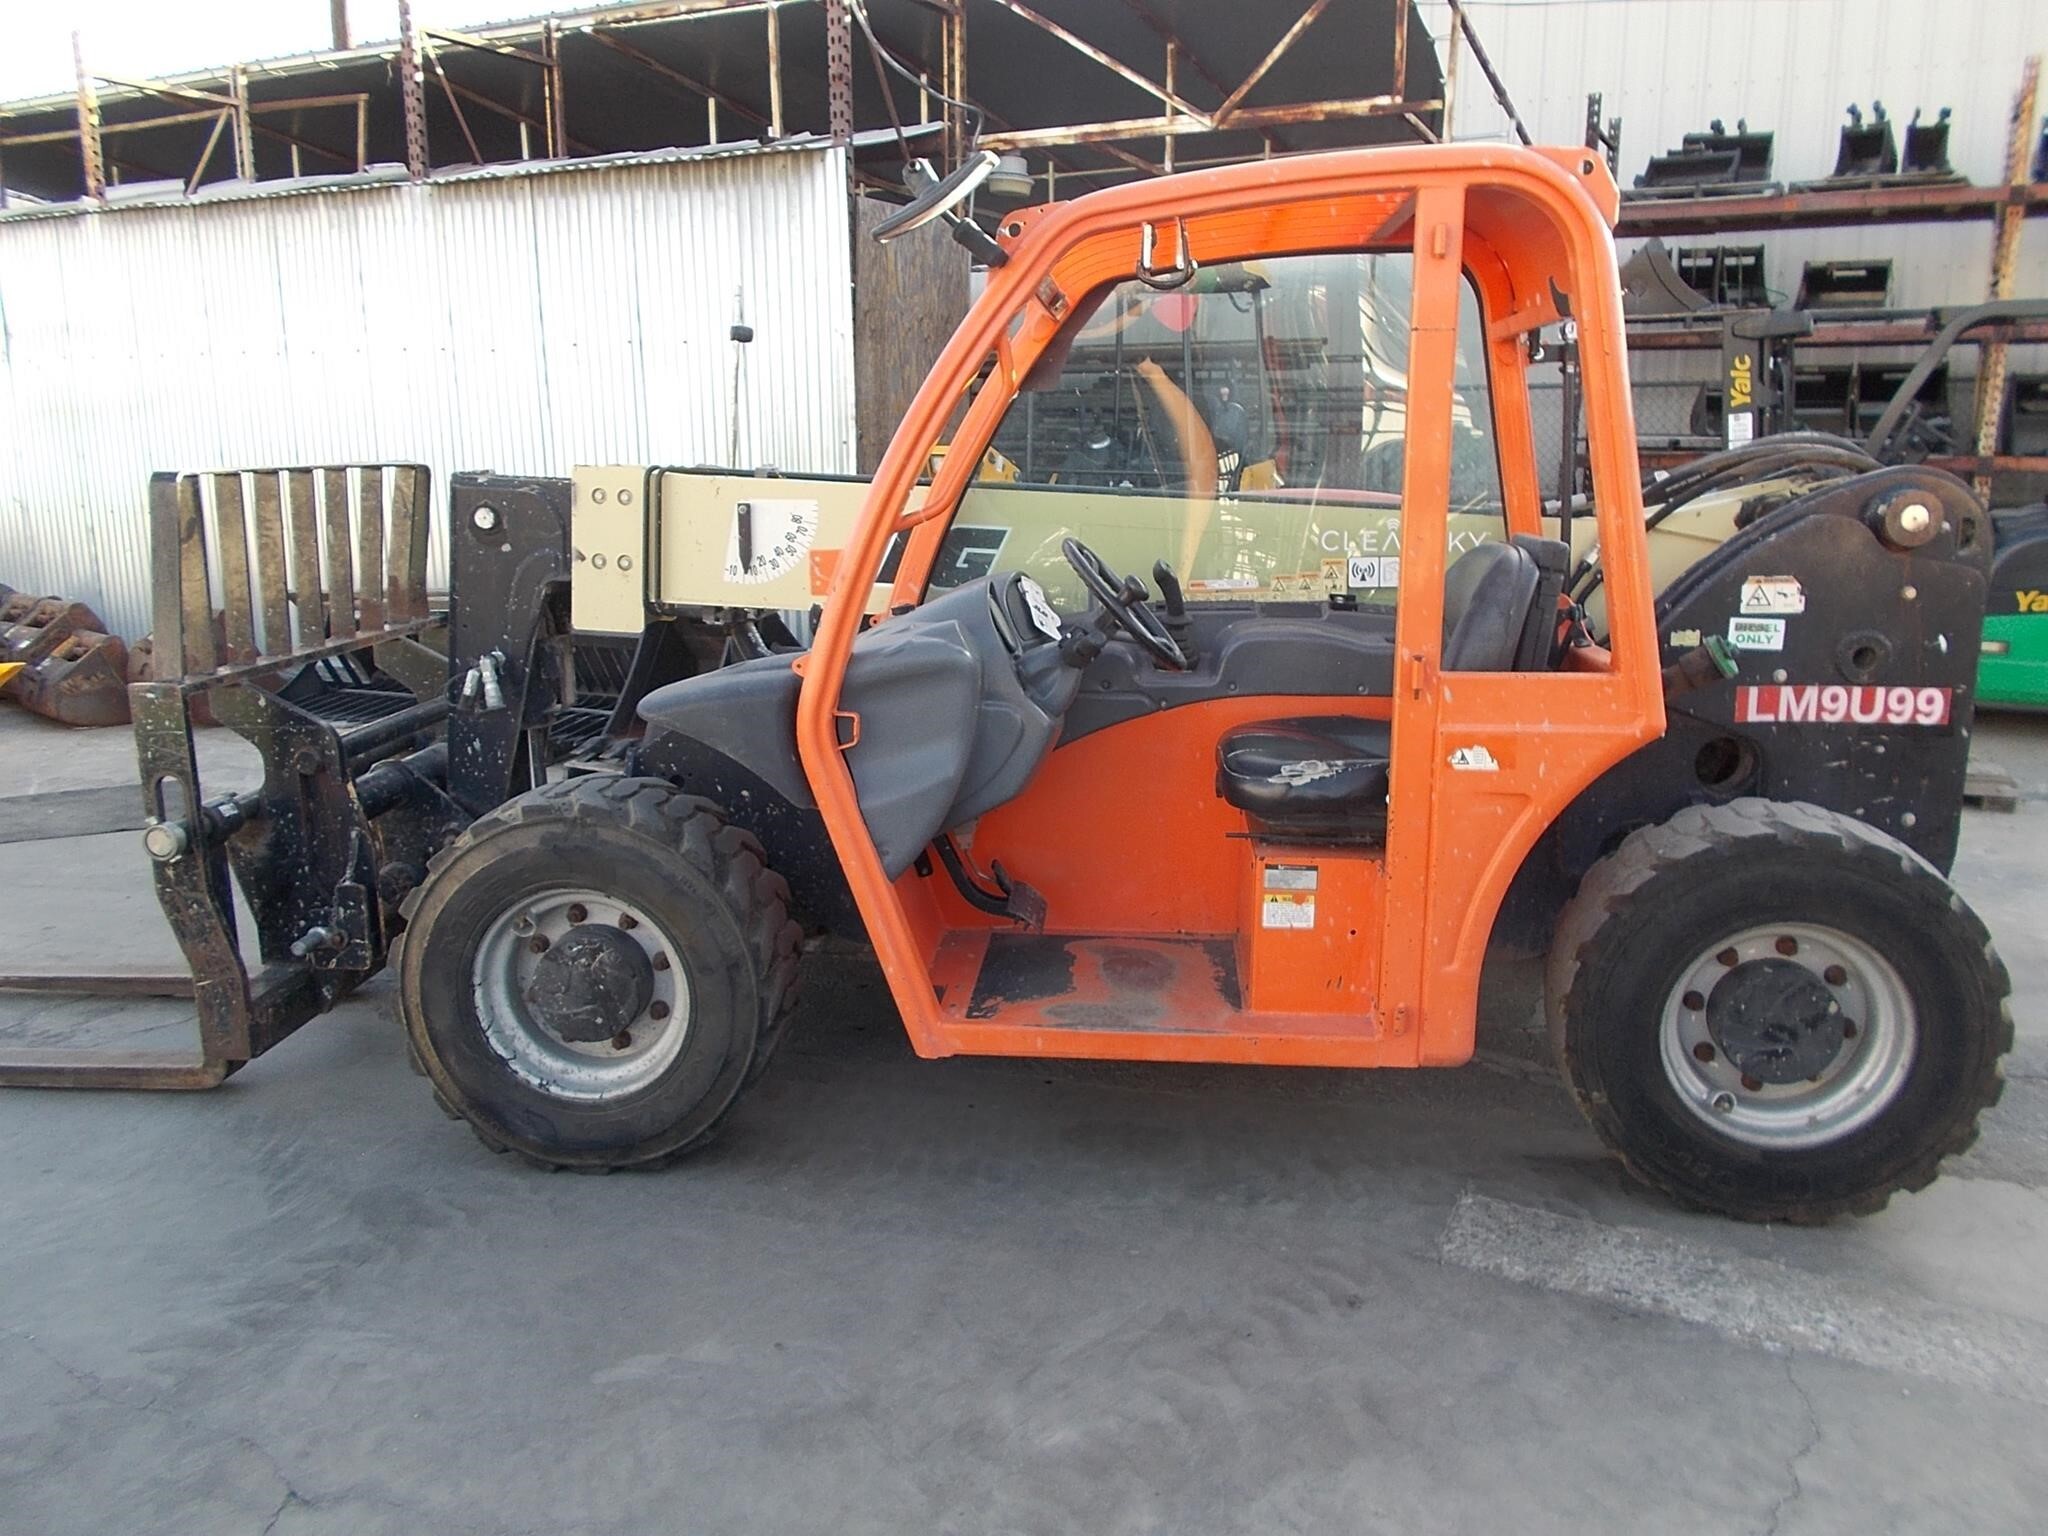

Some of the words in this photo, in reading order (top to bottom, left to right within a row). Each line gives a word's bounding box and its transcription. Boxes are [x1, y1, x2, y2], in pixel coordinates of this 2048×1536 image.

[1730, 354, 1751, 408] Yale
[784, 531, 797, 543] 60
[795, 525, 809, 536] 70
[1321, 529, 1487, 552] CLEAKY
[774, 545, 785, 557] 40
[784, 544, 797, 557] 50
[756, 554, 767, 568] 20
[768, 558, 780, 571] 30
[1735, 633, 1774, 645] ONLY
[1747, 685, 1945, 726] LM9U99
